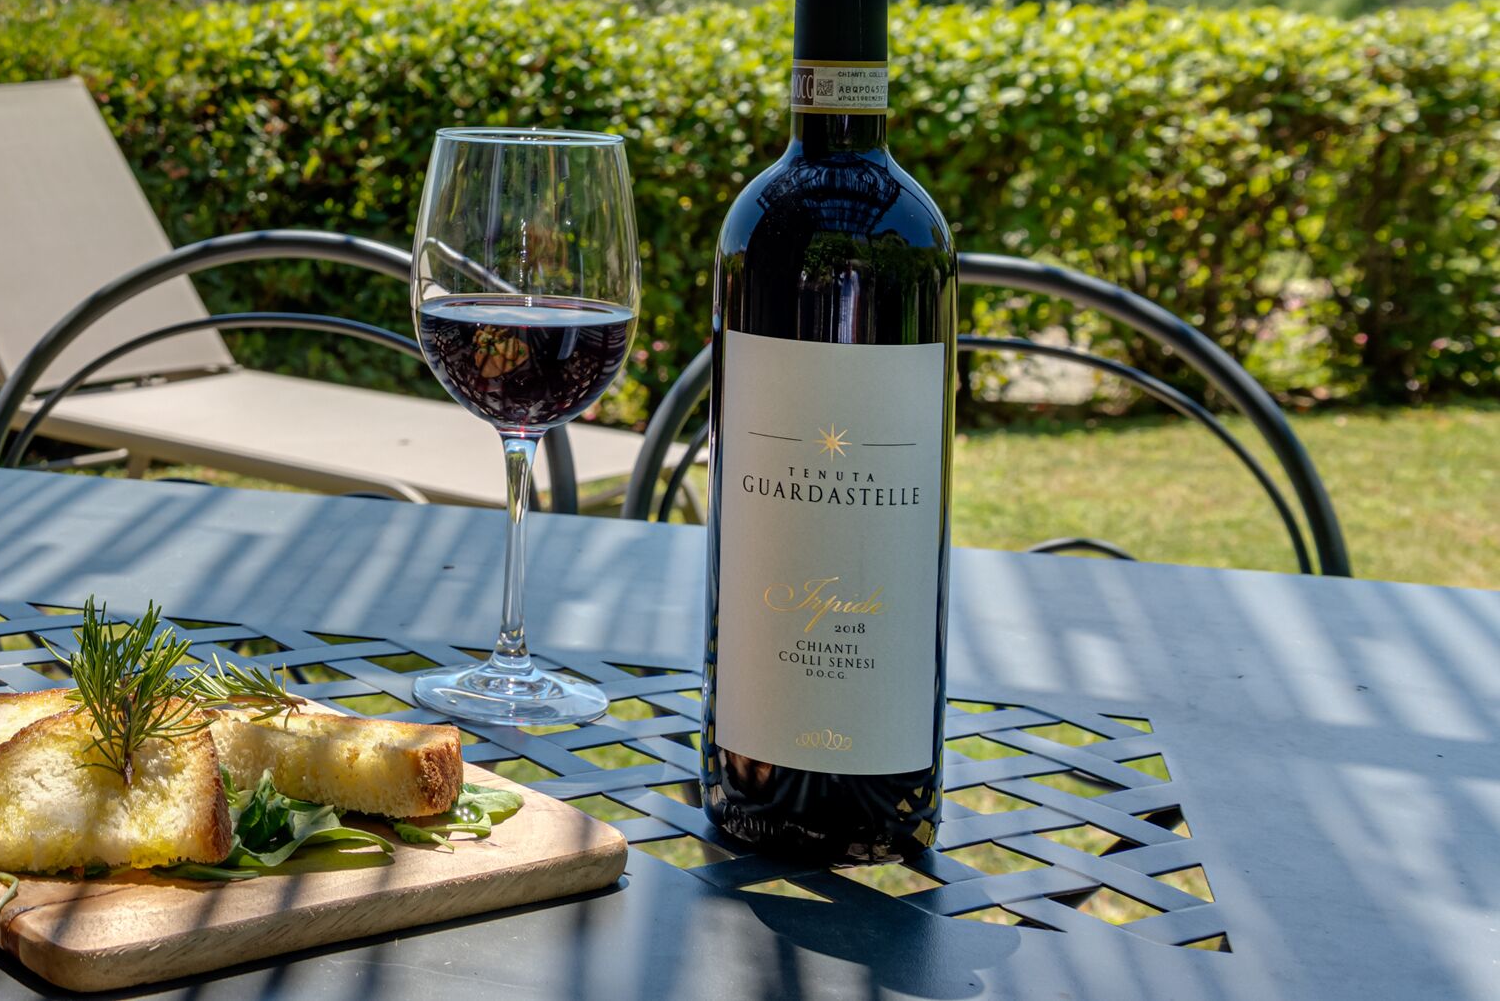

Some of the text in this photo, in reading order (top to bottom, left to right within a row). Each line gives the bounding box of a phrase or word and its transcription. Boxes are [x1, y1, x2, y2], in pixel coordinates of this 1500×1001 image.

[788, 466, 875, 483] TENUTA
[742, 474, 920, 506] GUARDASTELLE
[834, 622, 866, 634] 2018
[796, 639, 859, 655] CHIANTI
[778, 650, 875, 669] COLLI SENESI
